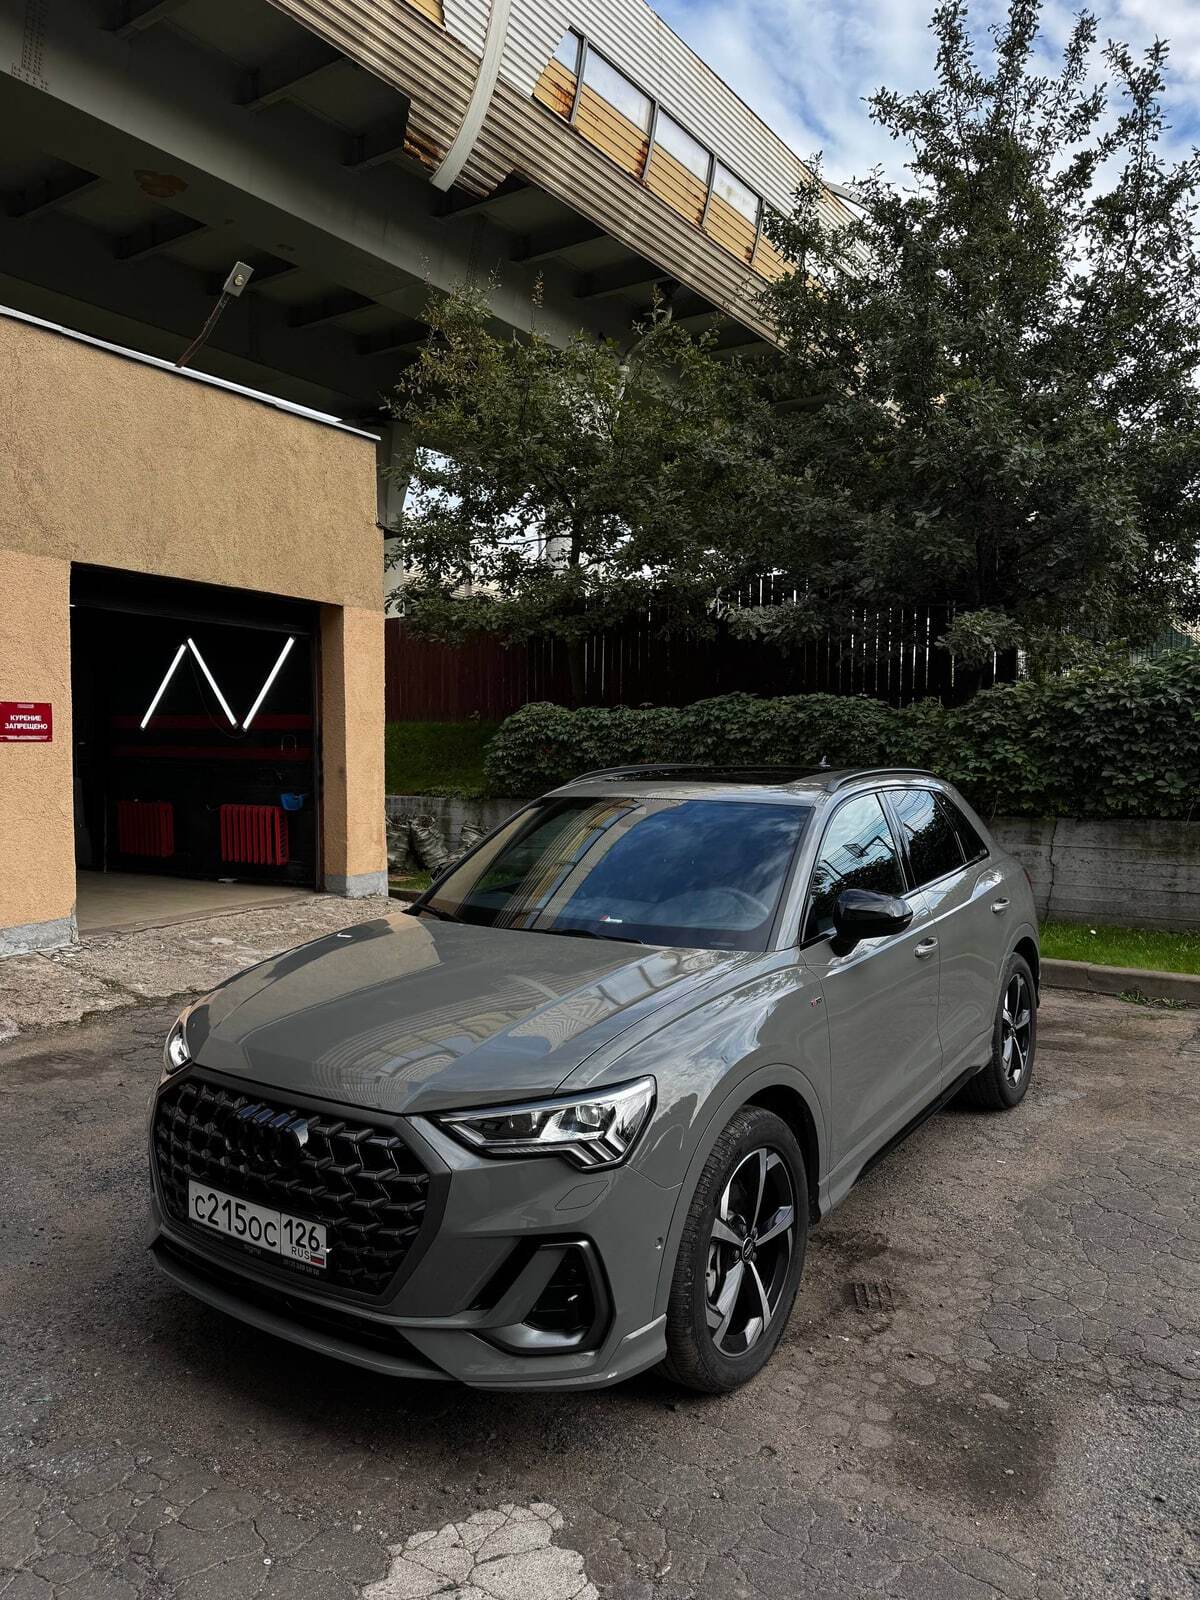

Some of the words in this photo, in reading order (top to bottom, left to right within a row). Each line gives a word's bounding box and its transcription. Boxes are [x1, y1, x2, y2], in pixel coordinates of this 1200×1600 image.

[4, 722, 48, 730] ЗАПРЕЩЕНО
[283, 1218, 321, 1252] 126
[291, 1246, 310, 1260] RUS
